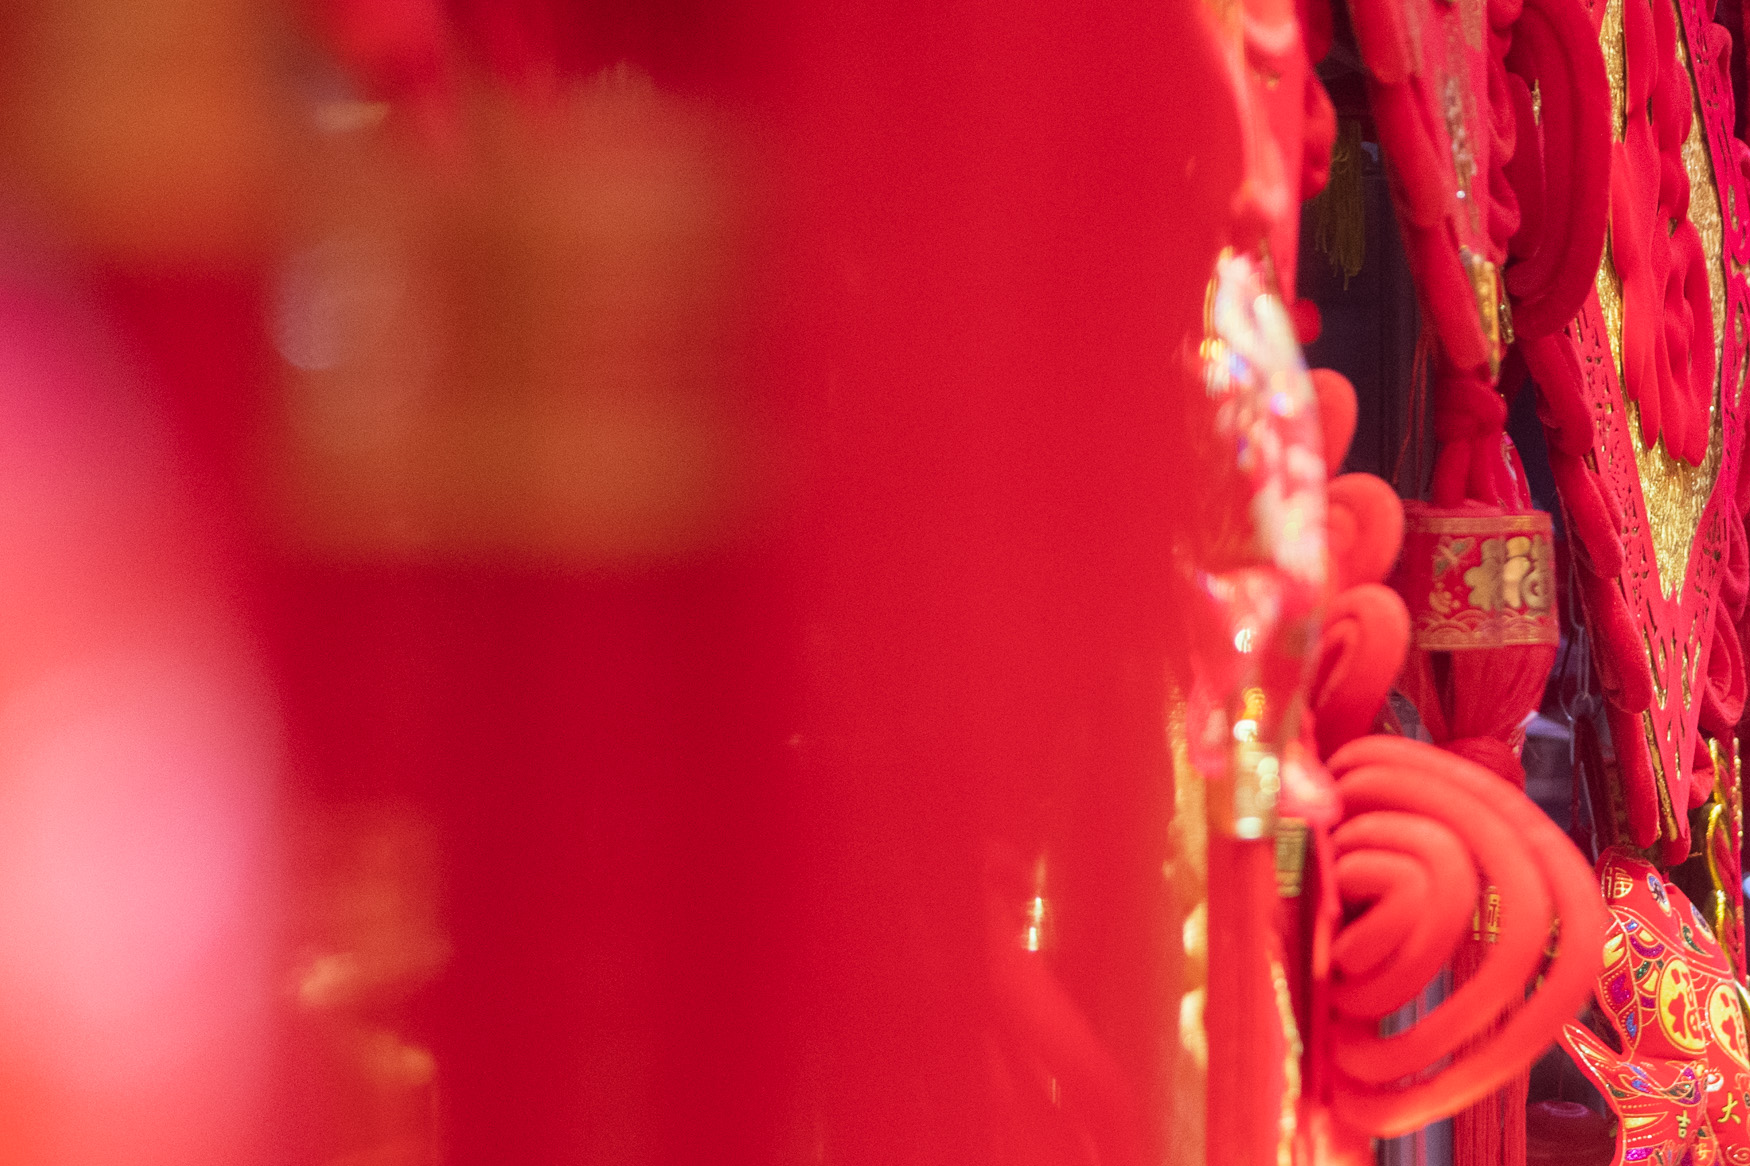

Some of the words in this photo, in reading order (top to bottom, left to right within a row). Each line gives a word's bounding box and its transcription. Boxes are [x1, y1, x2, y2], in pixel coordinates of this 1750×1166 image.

[1605, 866, 1633, 899] 福
[1676, 1109, 1691, 1138] 吉
[1717, 1091, 1742, 1125] 大
